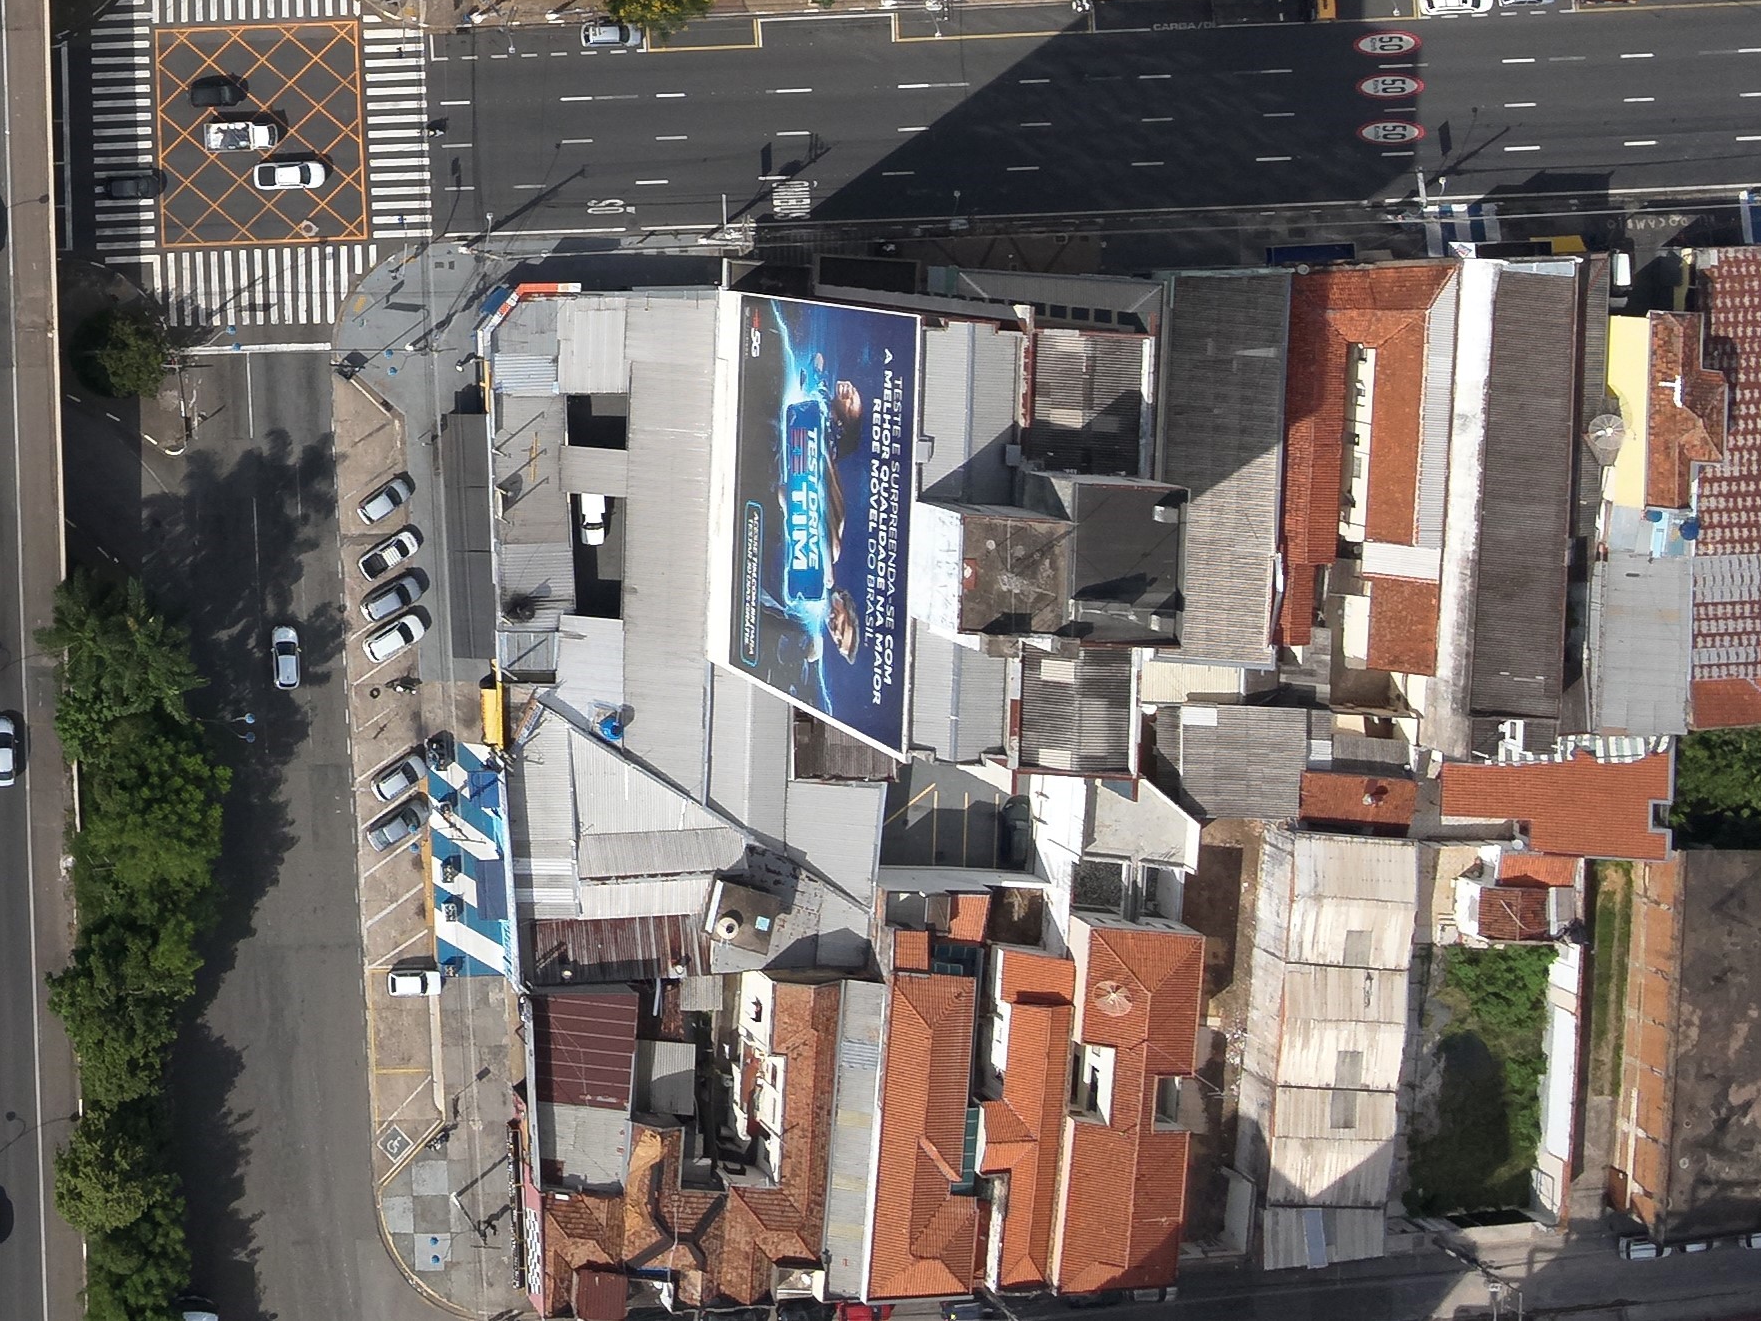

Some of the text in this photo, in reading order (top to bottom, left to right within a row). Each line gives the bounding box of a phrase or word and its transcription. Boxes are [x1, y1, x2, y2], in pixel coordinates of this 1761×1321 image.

[1379, 36, 1403, 52] 50
[1381, 78, 1406, 94] 50
[1382, 125, 1407, 140] 50
[750, 327, 761, 358] 5G
[872, 399, 881, 453] REDE
[808, 427, 818, 569] TEST DRIVE
[868, 459, 881, 532] MÓVEL
[792, 481, 807, 569] TIM
[872, 348, 893, 705] A MELHOR QUALIDADE NA MAIOR
[884, 377, 902, 685] TESTE E SURPREENDA-SE COM
[867, 539, 876, 570] DO
